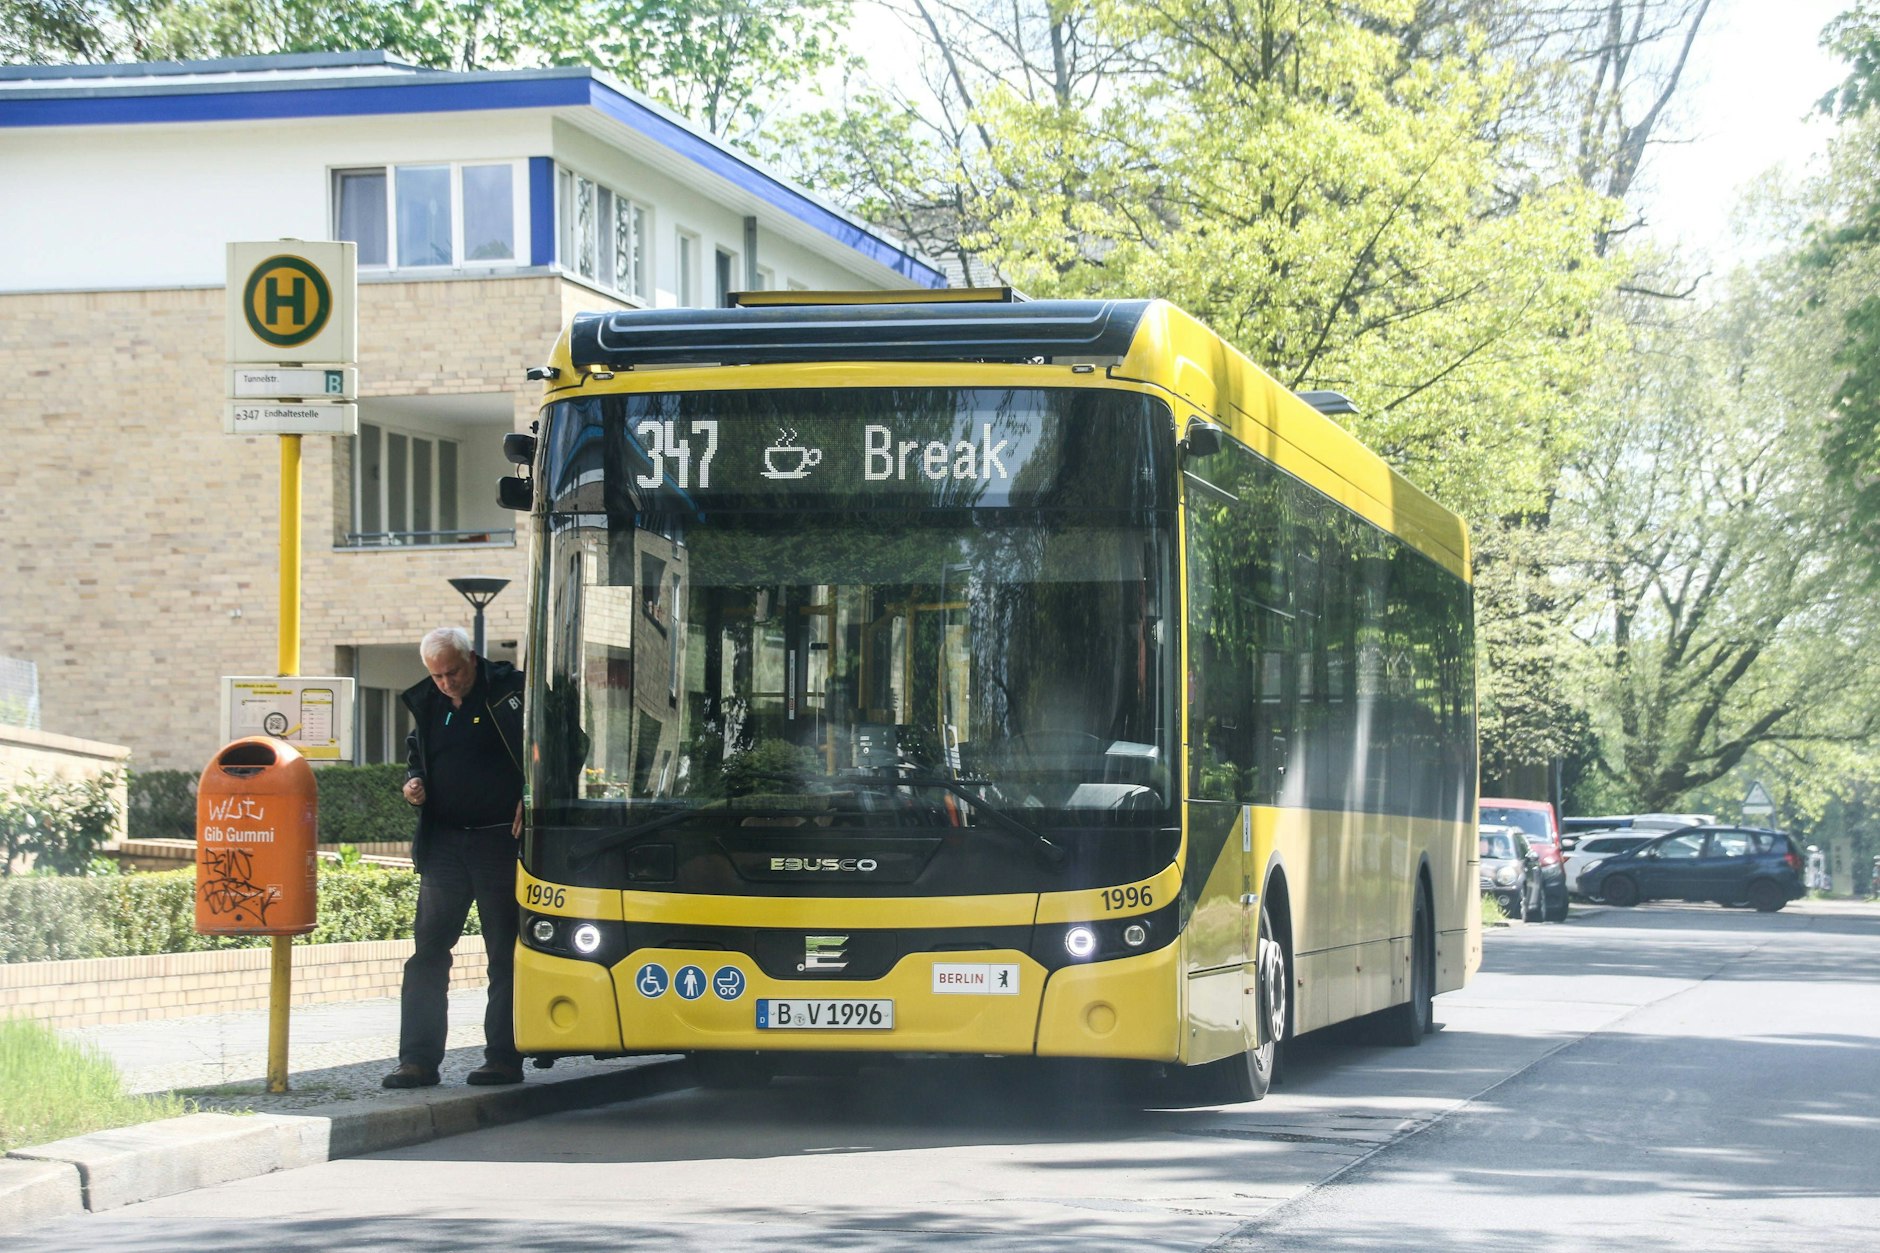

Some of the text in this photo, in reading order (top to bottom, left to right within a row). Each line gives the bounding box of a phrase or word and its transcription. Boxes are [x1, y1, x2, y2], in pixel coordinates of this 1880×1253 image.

[265, 277, 306, 325] H
[243, 374, 280, 383] Tunnelstr.
[328, 374, 341, 395] B
[242, 409, 319, 421] 347 Endhaltestelle
[637, 420, 1009, 489] 347 Break
[204, 826, 274, 843] Gib Gummi
[770, 857, 878, 871] EBUSCO
[526, 883, 566, 909] 1996
[1101, 885, 1153, 911] 1996
[938, 972, 984, 985] BERLIN
[778, 1003, 882, 1025] B V 1996
